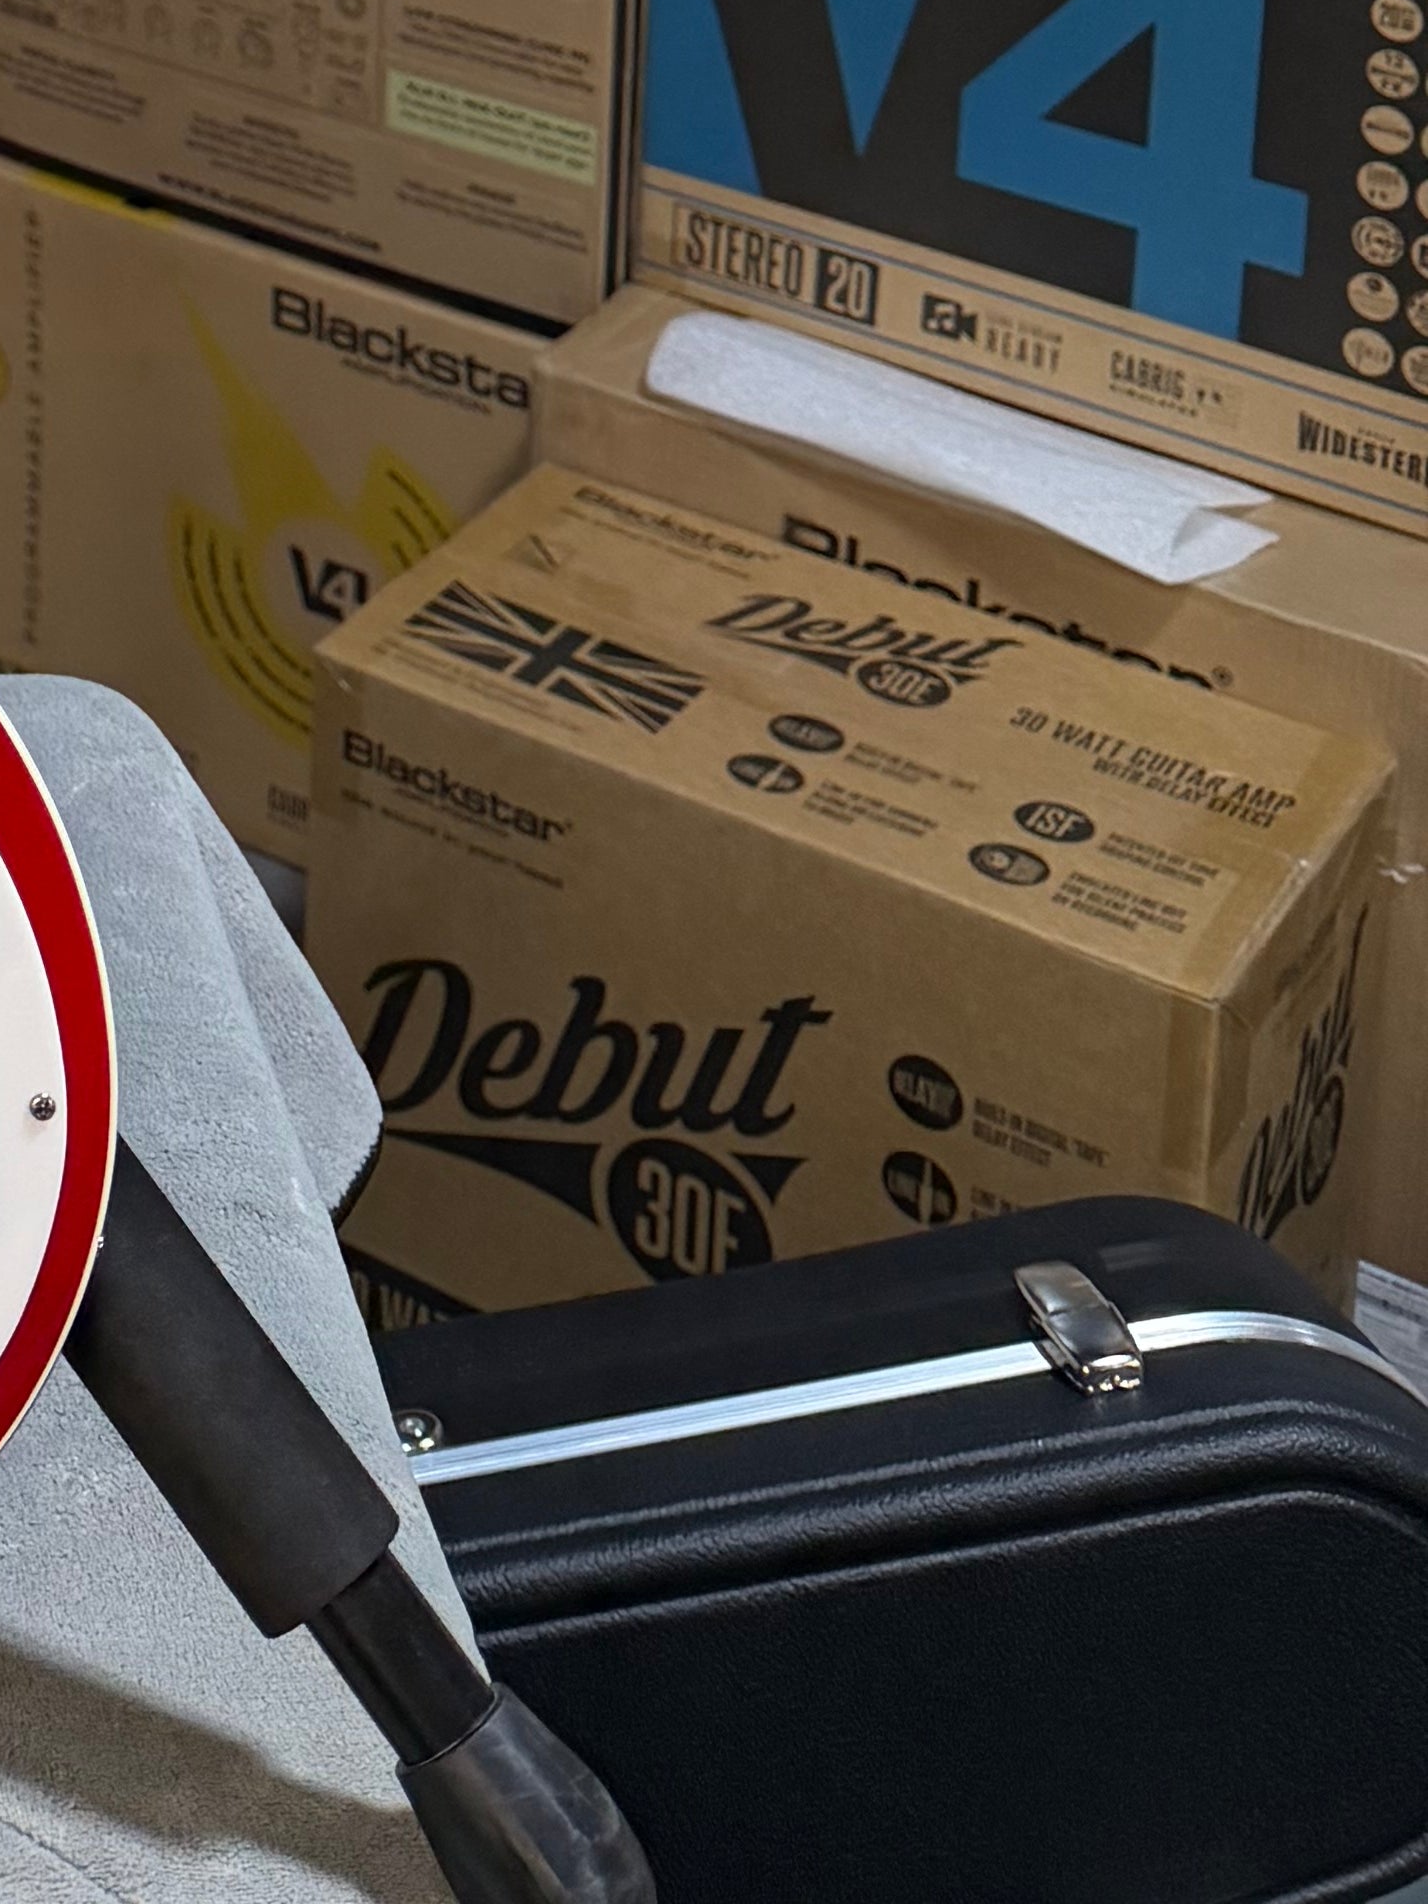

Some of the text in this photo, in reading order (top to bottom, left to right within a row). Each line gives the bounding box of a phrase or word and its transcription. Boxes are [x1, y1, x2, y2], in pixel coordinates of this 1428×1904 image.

[685, 211, 872, 318] STEREO 20
[273, 286, 531, 410] Blacksta
[1297, 410, 1428, 489] WIDESTER
[703, 594, 1026, 668] Debut
[870, 659, 935, 705] 30E
[343, 729, 566, 842] Blackstar
[1010, 706, 1299, 813] 30 WATT GUITAR AMP
[1024, 804, 1081, 839] ISF
[362, 958, 836, 1138] Debut
